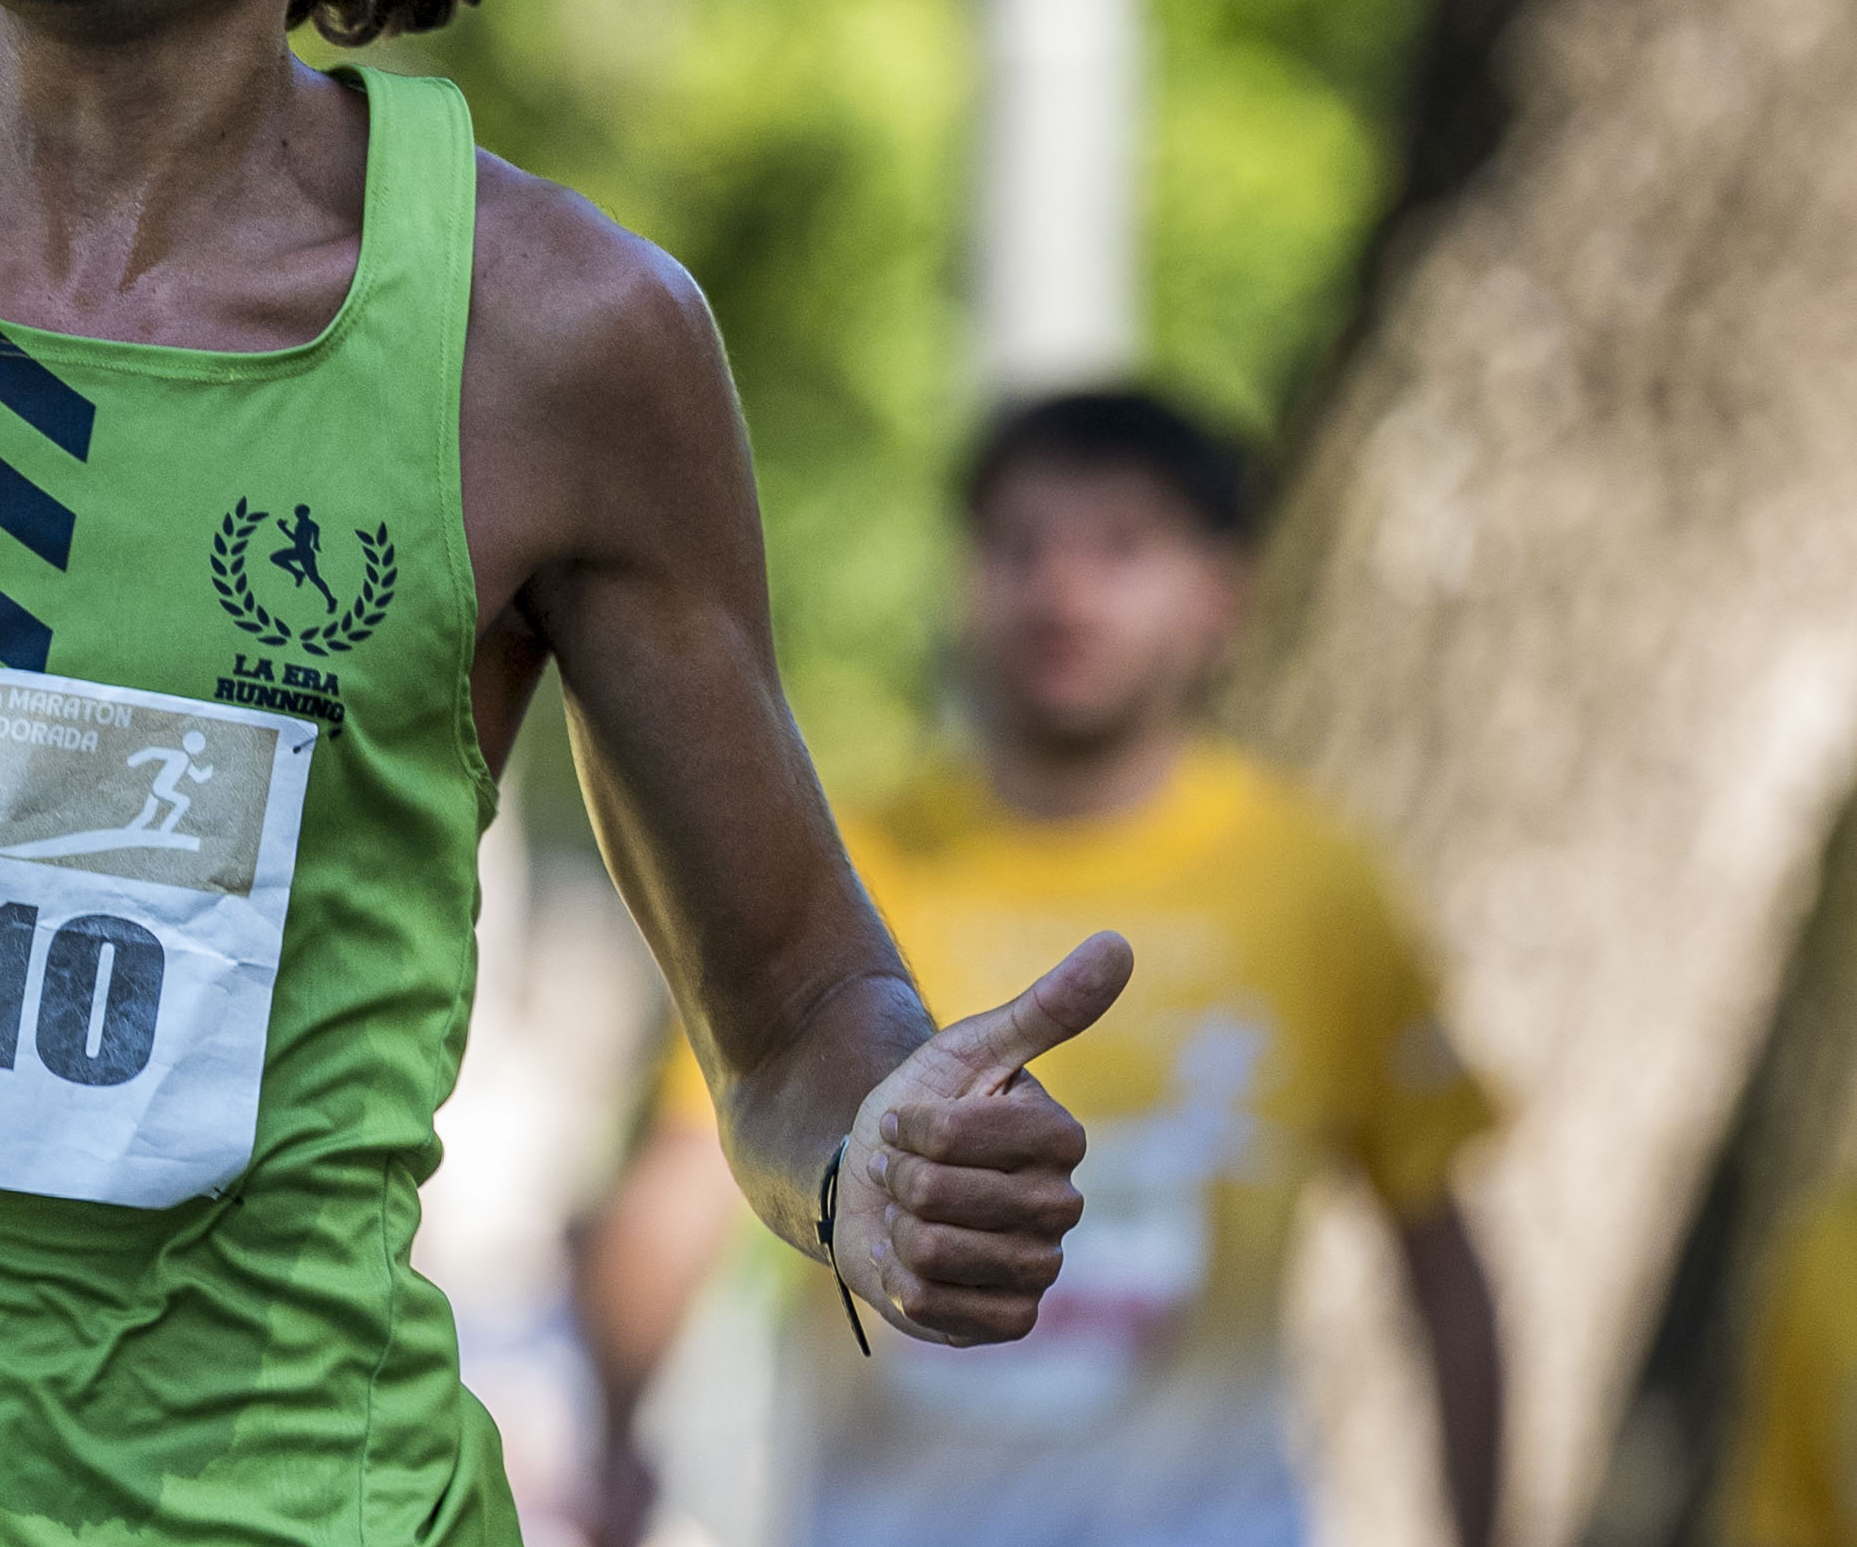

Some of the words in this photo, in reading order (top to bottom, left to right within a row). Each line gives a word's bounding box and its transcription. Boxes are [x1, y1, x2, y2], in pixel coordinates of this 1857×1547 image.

[233, 654, 275, 682] LA
[282, 663, 340, 697] ERA
[8, 688, 133, 729] MARATON
[214, 677, 345, 723] RUNNING
